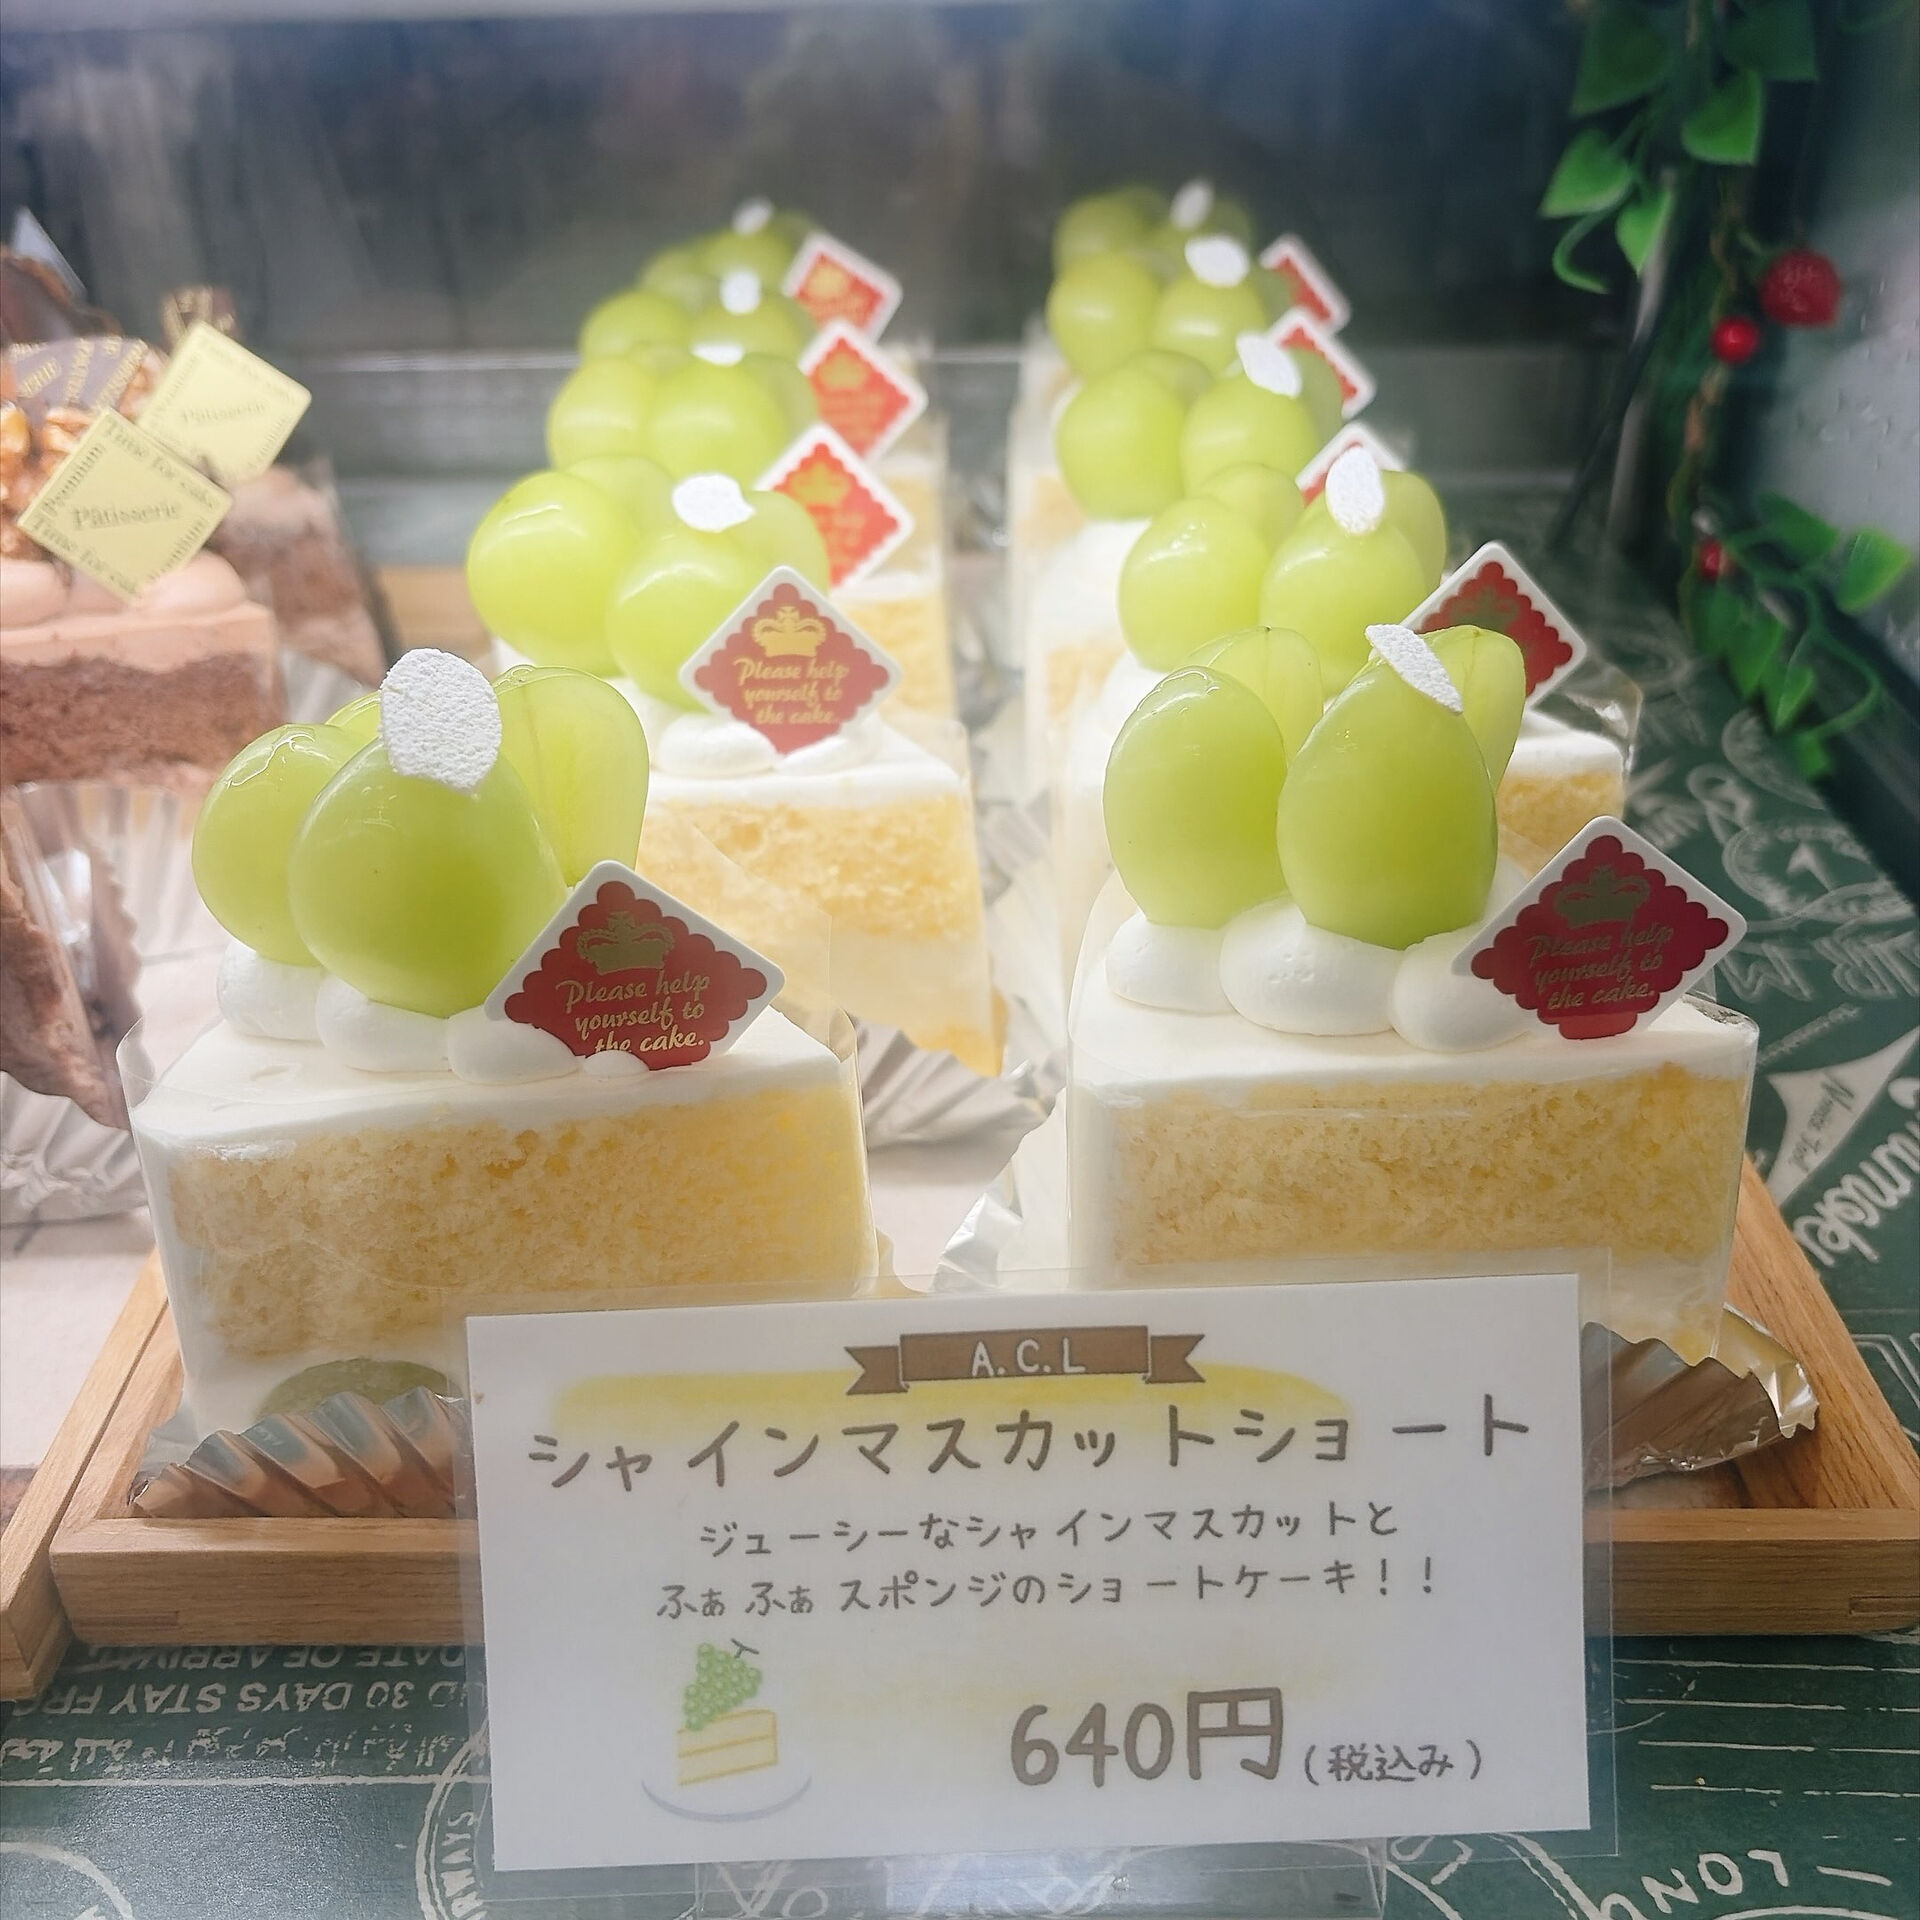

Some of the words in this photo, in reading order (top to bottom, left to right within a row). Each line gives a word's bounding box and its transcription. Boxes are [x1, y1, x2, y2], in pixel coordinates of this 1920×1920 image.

[733, 657, 801, 686] Please
[805, 659, 849, 686] help
[743, 681, 820, 710] yourself
[823, 685, 843, 702] to
[755, 704, 784, 725] the
[1525, 934, 1613, 968] Please
[1620, 917, 1674, 953] help
[555, 979, 647, 1014] Please
[655, 969, 710, 1002] help
[1536, 950, 1632, 995] yourself
[1640, 953, 1663, 972] to
[1547, 983, 1584, 1011] the
[575, 997, 675, 1040] yourself
[682, 1001, 705, 1019] to
[639, 1024, 705, 1052] cake.
[971, 1338, 1086, 1377] A.C.L
[529, 1394, 1528, 1491] シャインマスカットショート
[700, 1501, 1397, 1557] ジューシーなシャインマスカットと
[109, 1682, 227, 1714] STAY
[237, 1682, 353, 1713] DAYS
[1011, 1687, 1283, 1787] 640円
